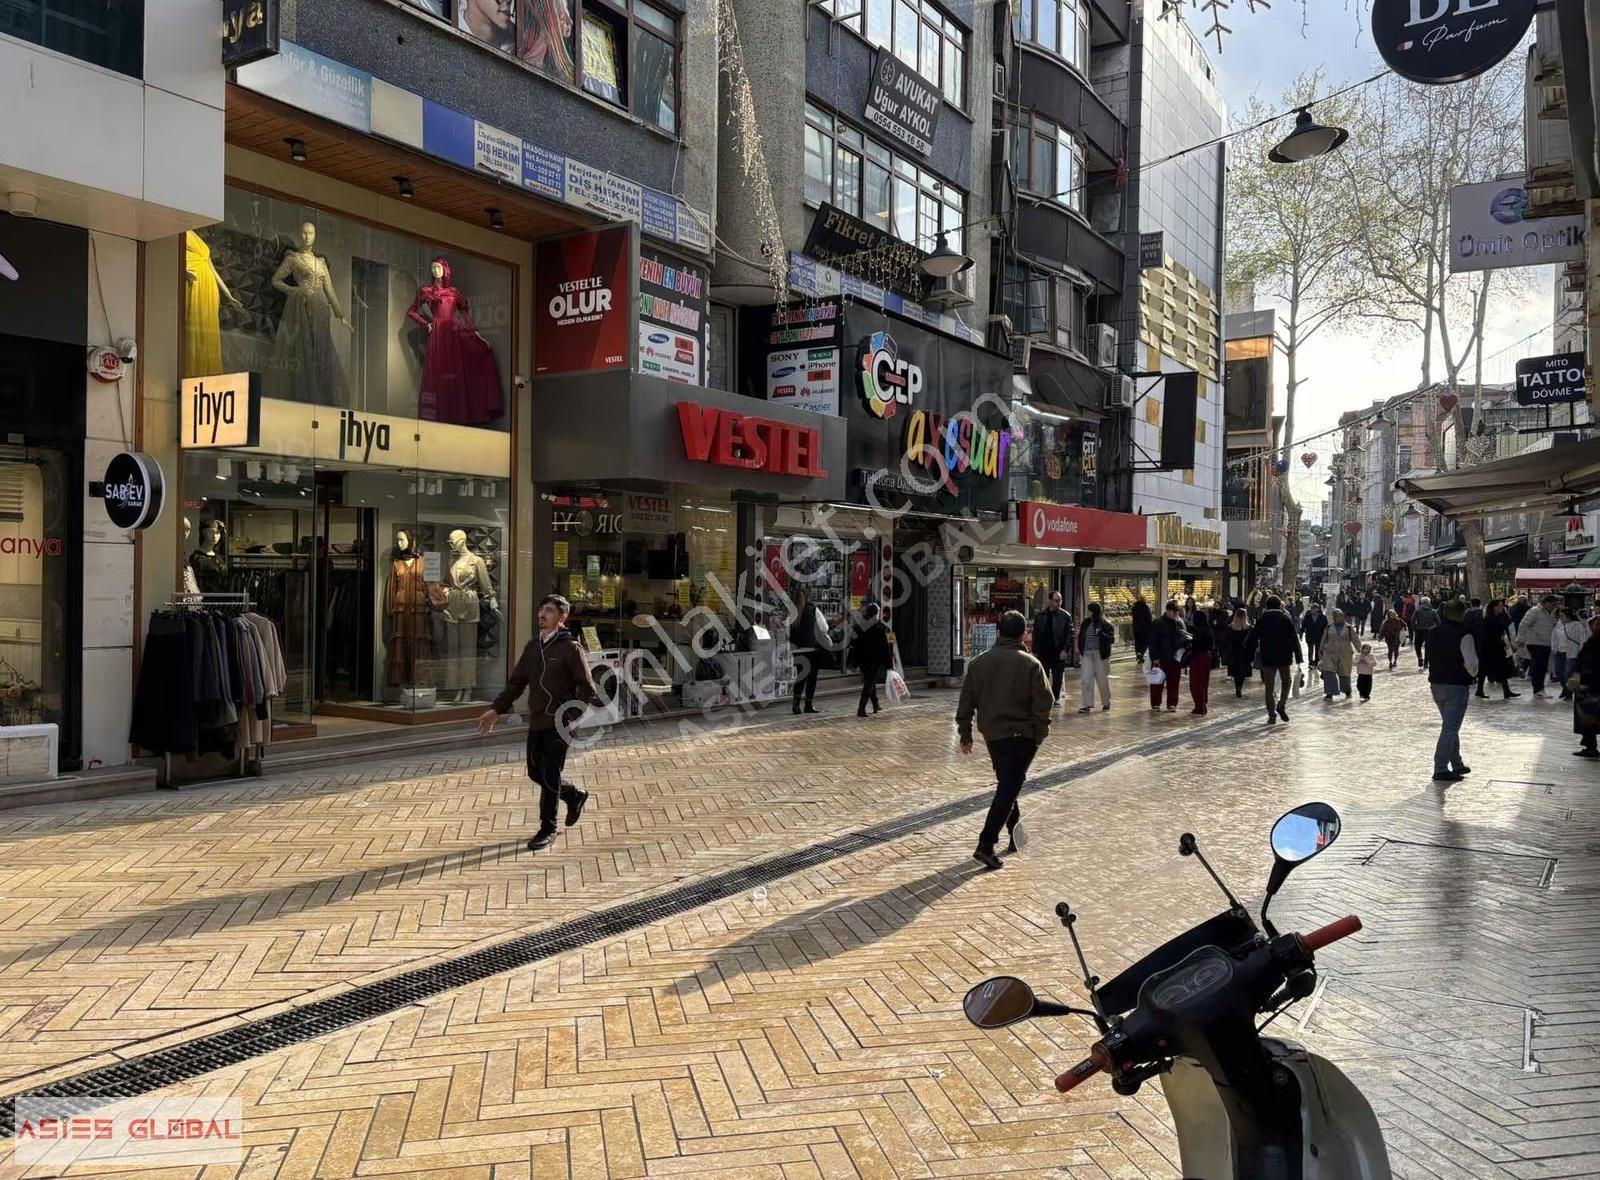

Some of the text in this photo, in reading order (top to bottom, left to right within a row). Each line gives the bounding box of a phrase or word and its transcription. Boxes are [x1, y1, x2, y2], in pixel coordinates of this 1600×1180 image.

[308, 60, 317, 77] &
[320, 65, 366, 97] Güzellik
[895, 73, 938, 114] AVUKAT
[873, 112, 892, 128] 0554
[874, 86, 931, 138] Uğur AYKOL
[477, 140, 491, 156] DİŞ
[491, 145, 521, 165] HEKİMİ
[568, 163, 602, 181] Nejdet
[567, 184, 590, 199] TEL:
[569, 174, 592, 190] DİŞ
[594, 183, 640, 208] HEKİMİ
[823, 210, 875, 248] Fikret
[1459, 225, 1586, 258] Ümit Optik
[559, 276, 602, 293] VESTEL'LE
[549, 288, 613, 319] OLUR
[605, 355, 623, 363] VESTEL
[771, 352, 799, 363] SONY
[808, 361, 837, 369] iPhone
[1545, 358, 1569, 368] MİTO
[872, 348, 923, 405] CEP
[1519, 368, 1585, 388] TATTO
[1532, 387, 1572, 399] DÖVME
[676, 400, 829, 480] VESTEL
[105, 483, 143, 500] SAREV
[629, 496, 669, 513] VESTEL
[1046, 516, 1078, 533] vodafone
[0, 537, 62, 559] anya
